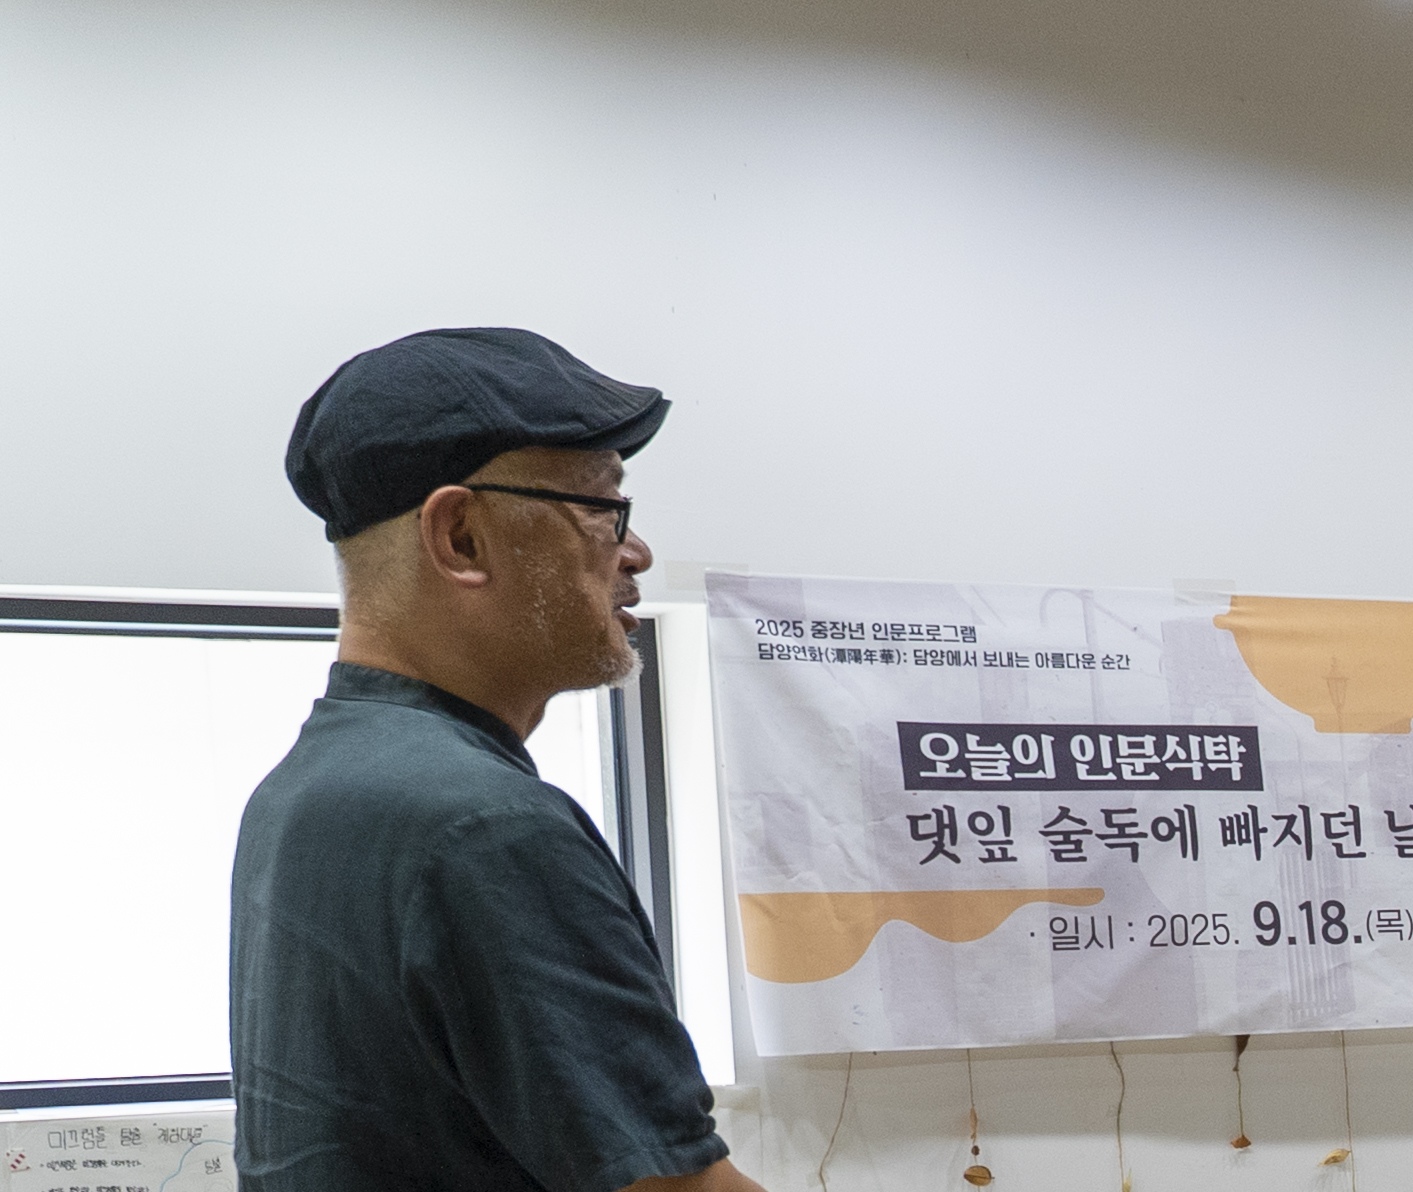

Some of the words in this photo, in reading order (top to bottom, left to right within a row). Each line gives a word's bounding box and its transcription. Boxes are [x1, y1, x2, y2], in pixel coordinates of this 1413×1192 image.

[754, 618, 805, 639] 2025
[809, 620, 866, 641] 중장년
[871, 623, 978, 643] 인문프로그램
[912, 649, 979, 668] 담양에서
[982, 651, 1031, 669] 보내는
[1034, 652, 1097, 670] 아름다운
[1100, 654, 1132, 670] 순간
[918, 729, 1058, 783] 오늘의
[1069, 732, 1248, 783] 인문식탁
[905, 803, 1019, 866] 댓잎
[1038, 803, 1200, 865] 술독에
[1218, 803, 1368, 863] 빠지던
[1048, 914, 1115, 951] 일시
[1147, 913, 1241, 948] 2025.
